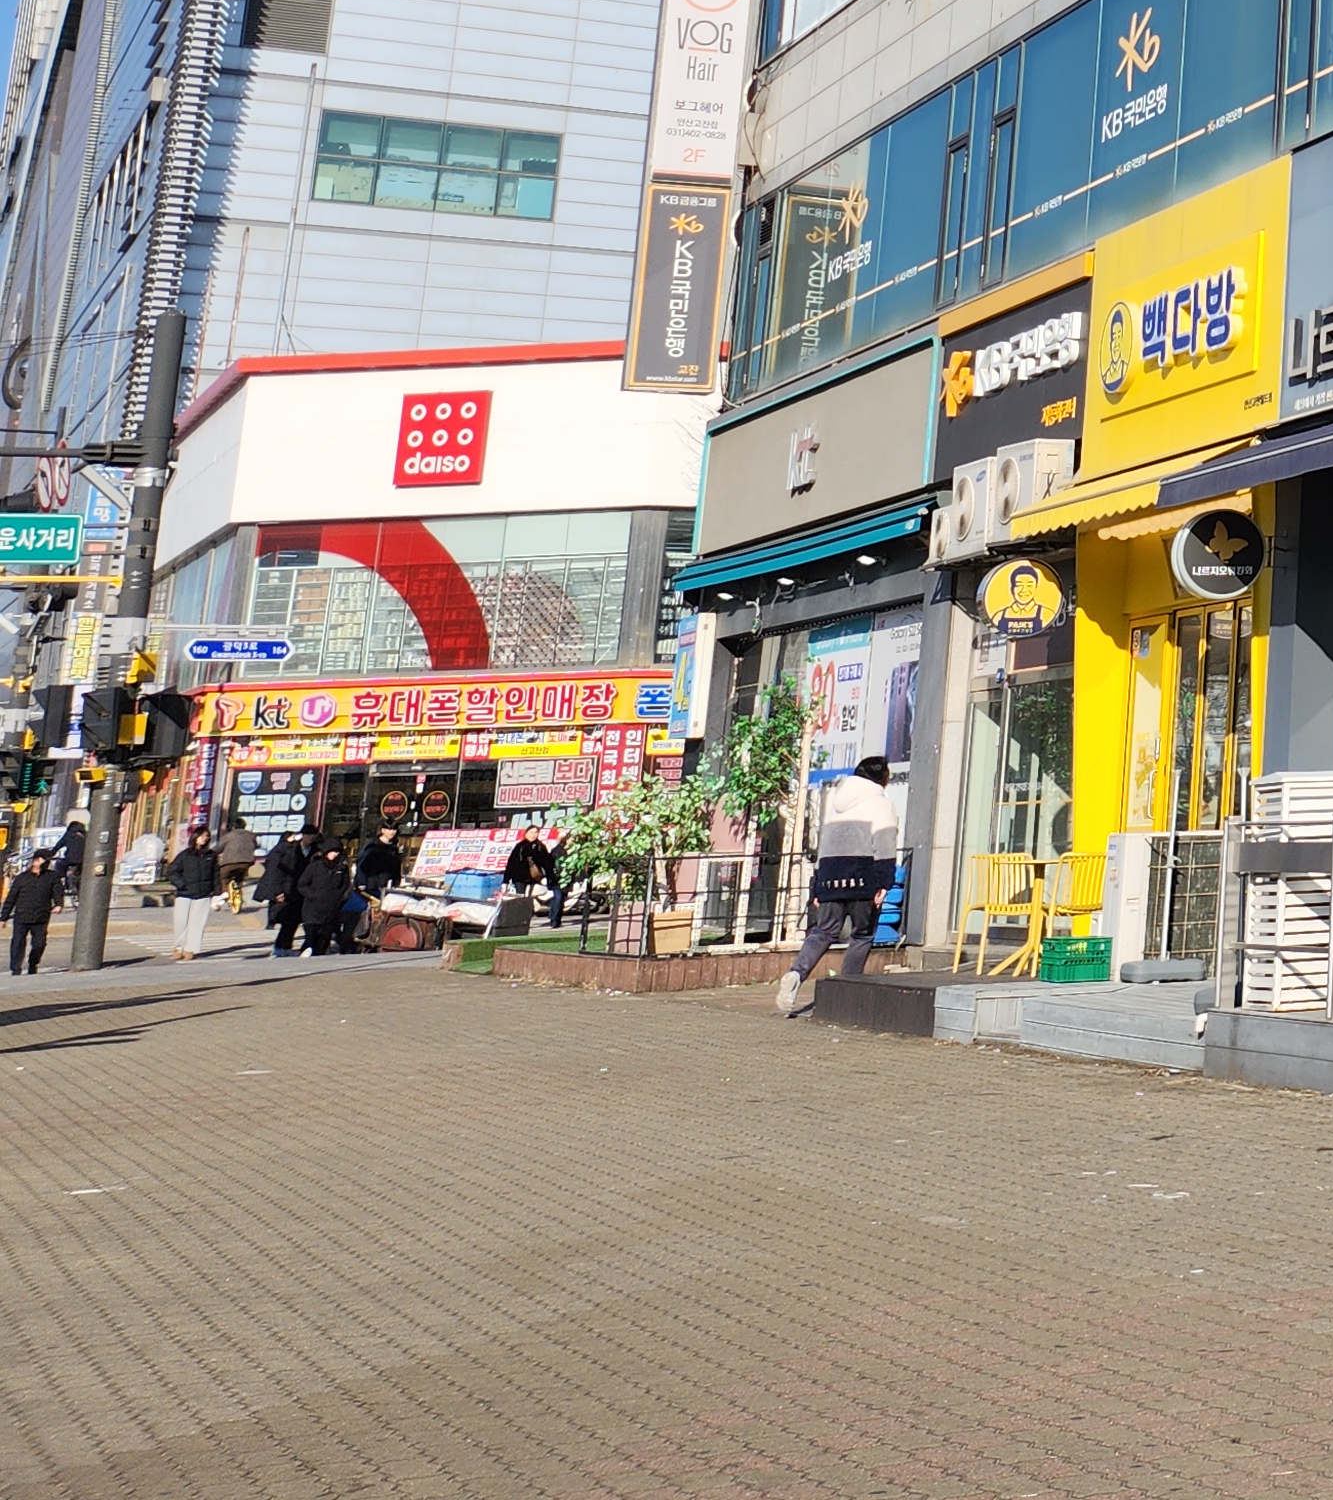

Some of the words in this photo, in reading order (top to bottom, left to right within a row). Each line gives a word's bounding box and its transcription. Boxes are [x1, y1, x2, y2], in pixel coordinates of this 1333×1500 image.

[678, 17, 733, 54] VOG
[687, 55, 719, 82] Hair
[674, 99, 724, 116] 보그헤어
[683, 148, 706, 164] 2F
[1141, 266, 1247, 368] 백다방
[677, 365, 700, 376] 고잔
[403, 451, 470, 475] daiso
[786, 421, 820, 494] kt
[253, 694, 292, 729] kt
[352, 682, 616, 729] 휴대폰할인매장
